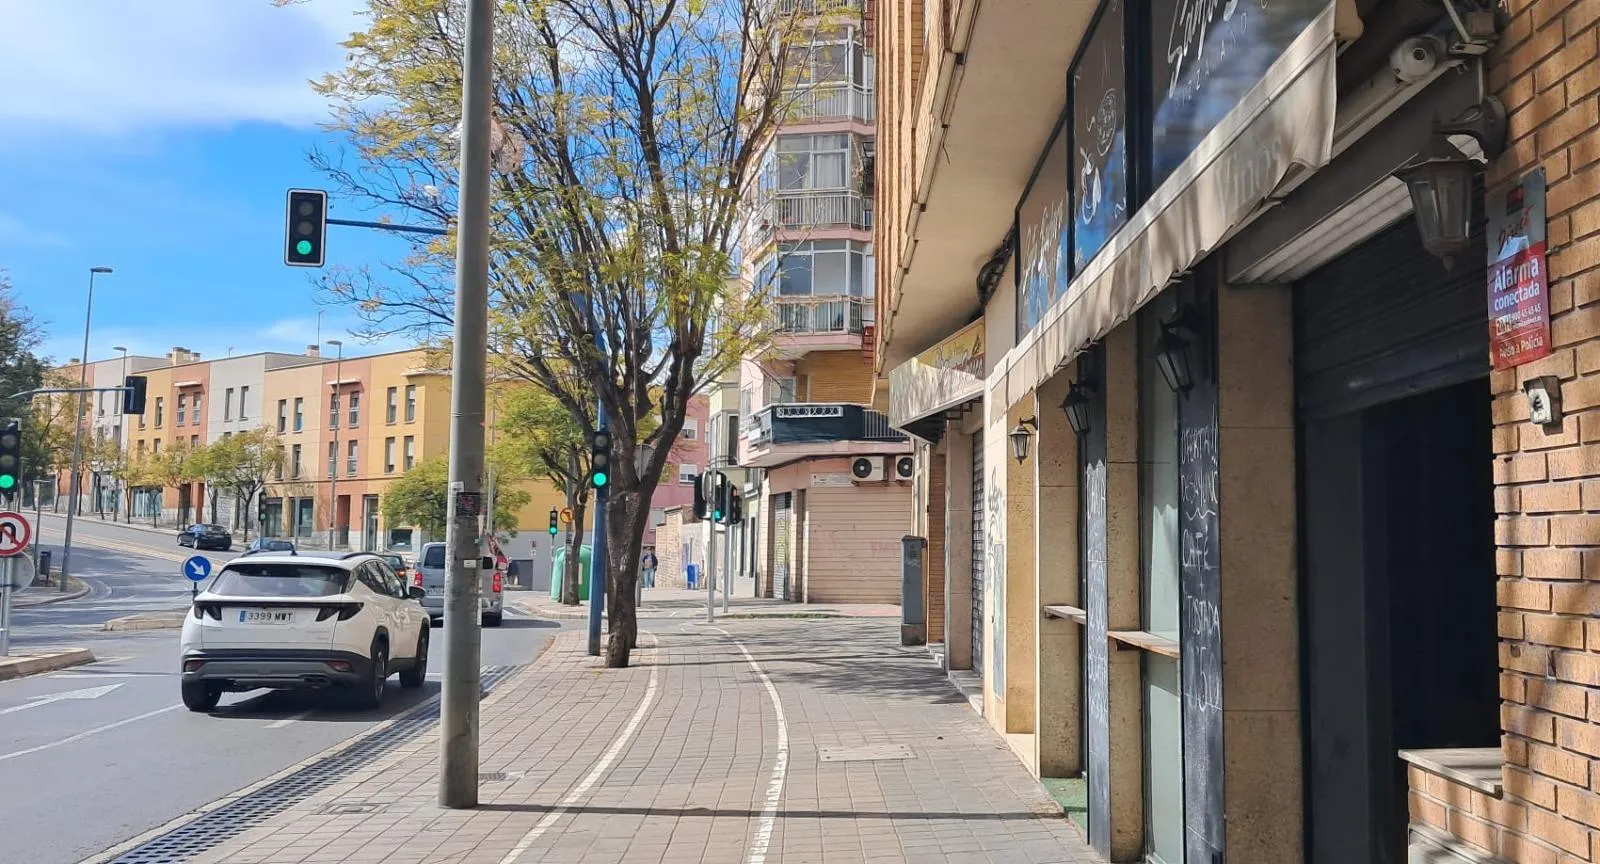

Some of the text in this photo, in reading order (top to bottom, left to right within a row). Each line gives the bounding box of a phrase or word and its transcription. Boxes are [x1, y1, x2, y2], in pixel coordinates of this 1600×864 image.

[1494, 257, 1540, 293] Alarma
[1494, 280, 1541, 311] conectada
[248, 612, 272, 621] 3399
